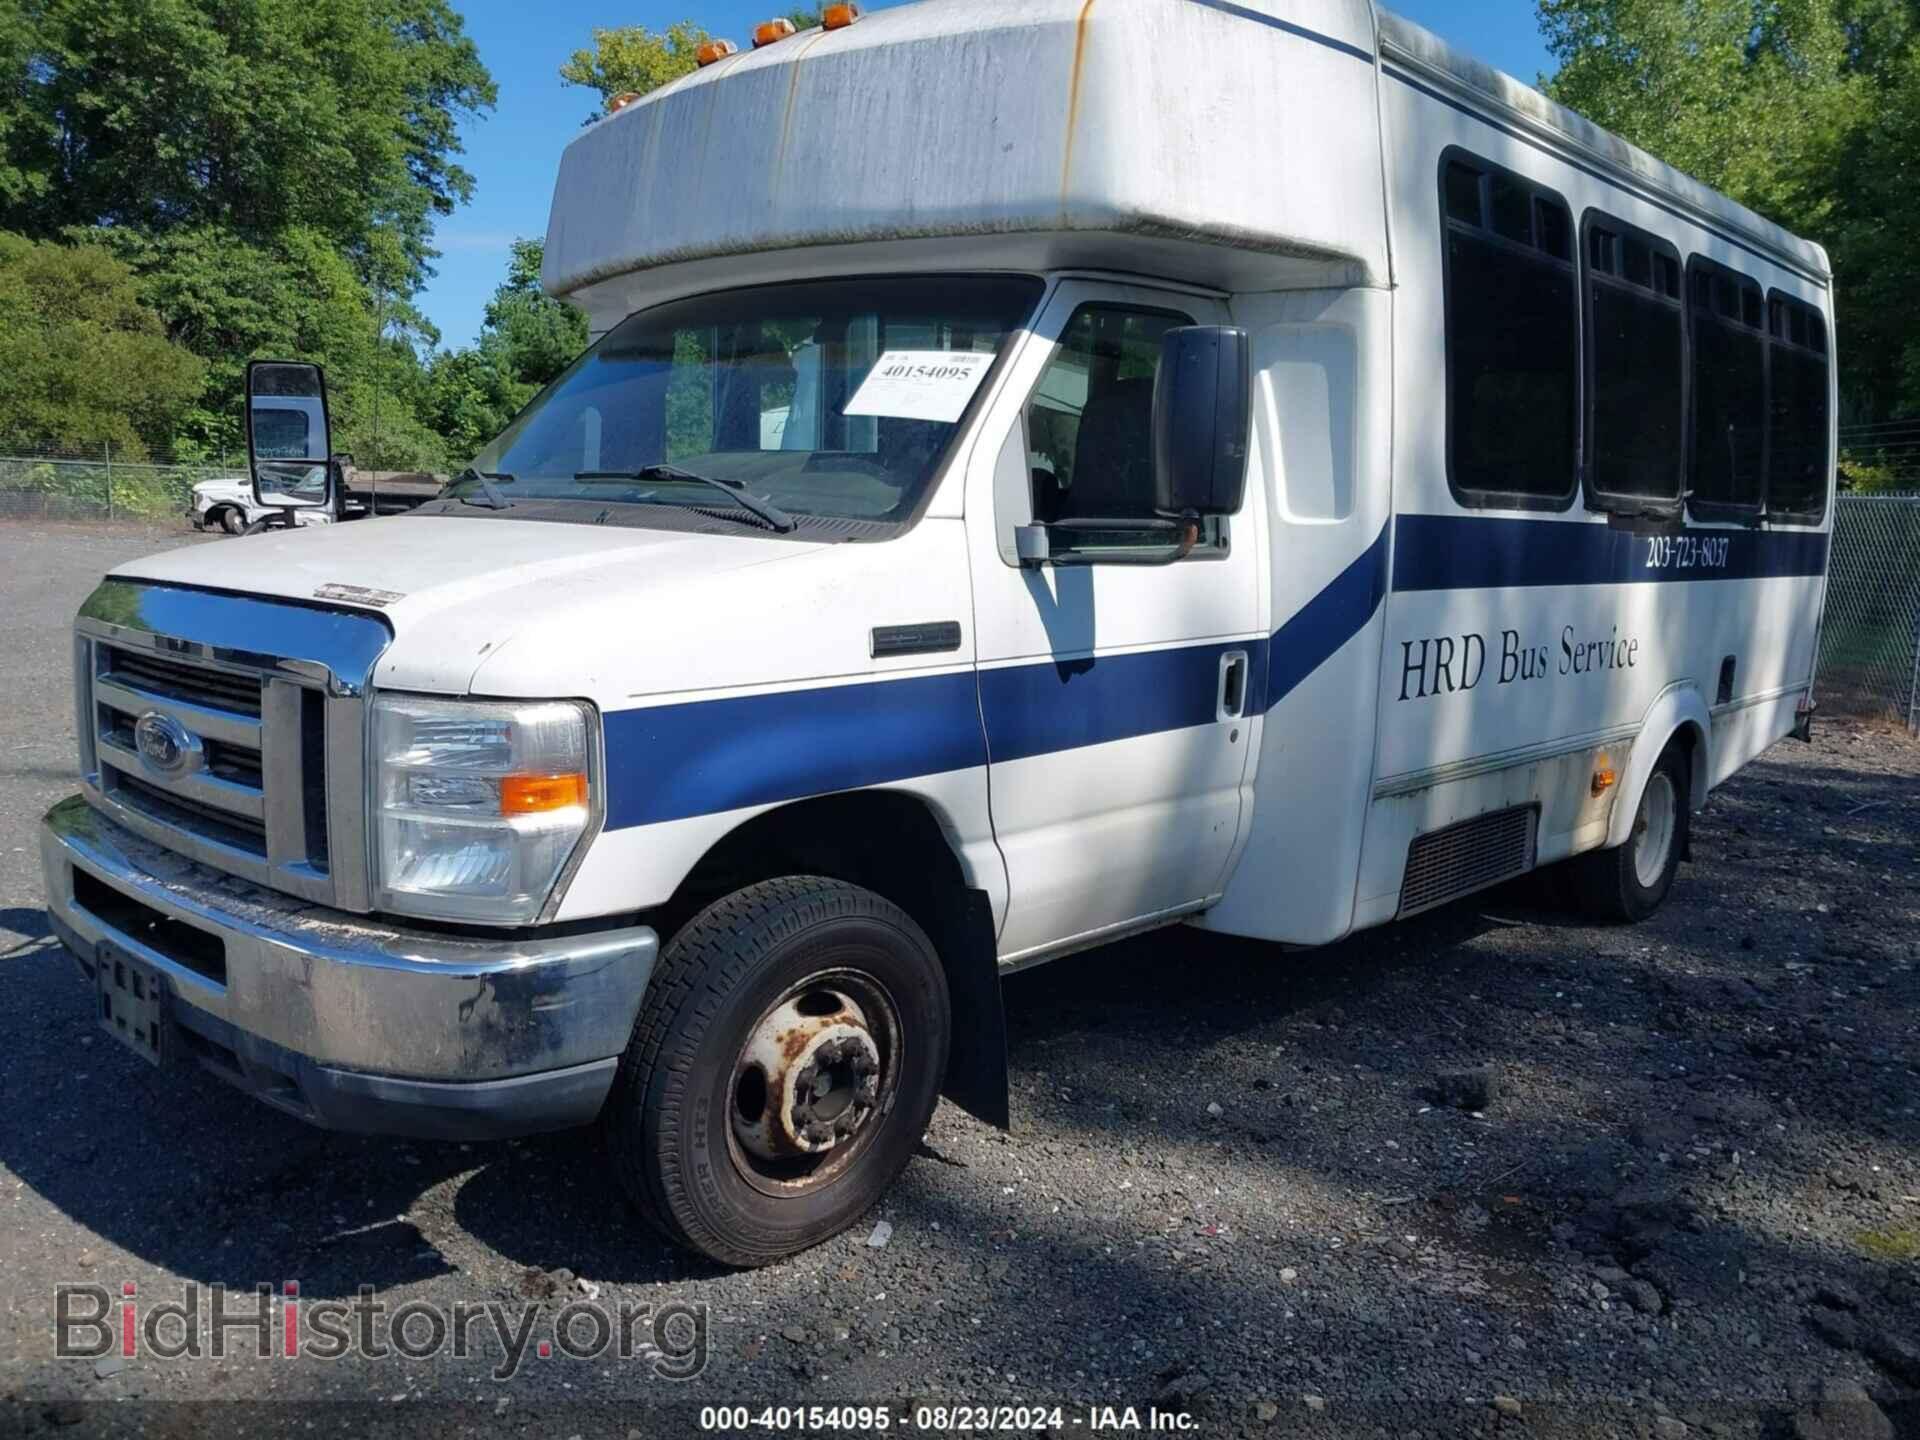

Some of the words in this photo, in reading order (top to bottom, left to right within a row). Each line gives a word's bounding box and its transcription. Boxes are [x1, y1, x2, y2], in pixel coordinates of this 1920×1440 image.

[881, 364, 972, 381] 40154095
[1645, 536, 1729, 568] 203-723-8037
[1398, 633, 1485, 700] HRD
[1498, 629, 1549, 684] Bus
[1558, 624, 1639, 675] Service
[142, 732, 169, 761] Ford
